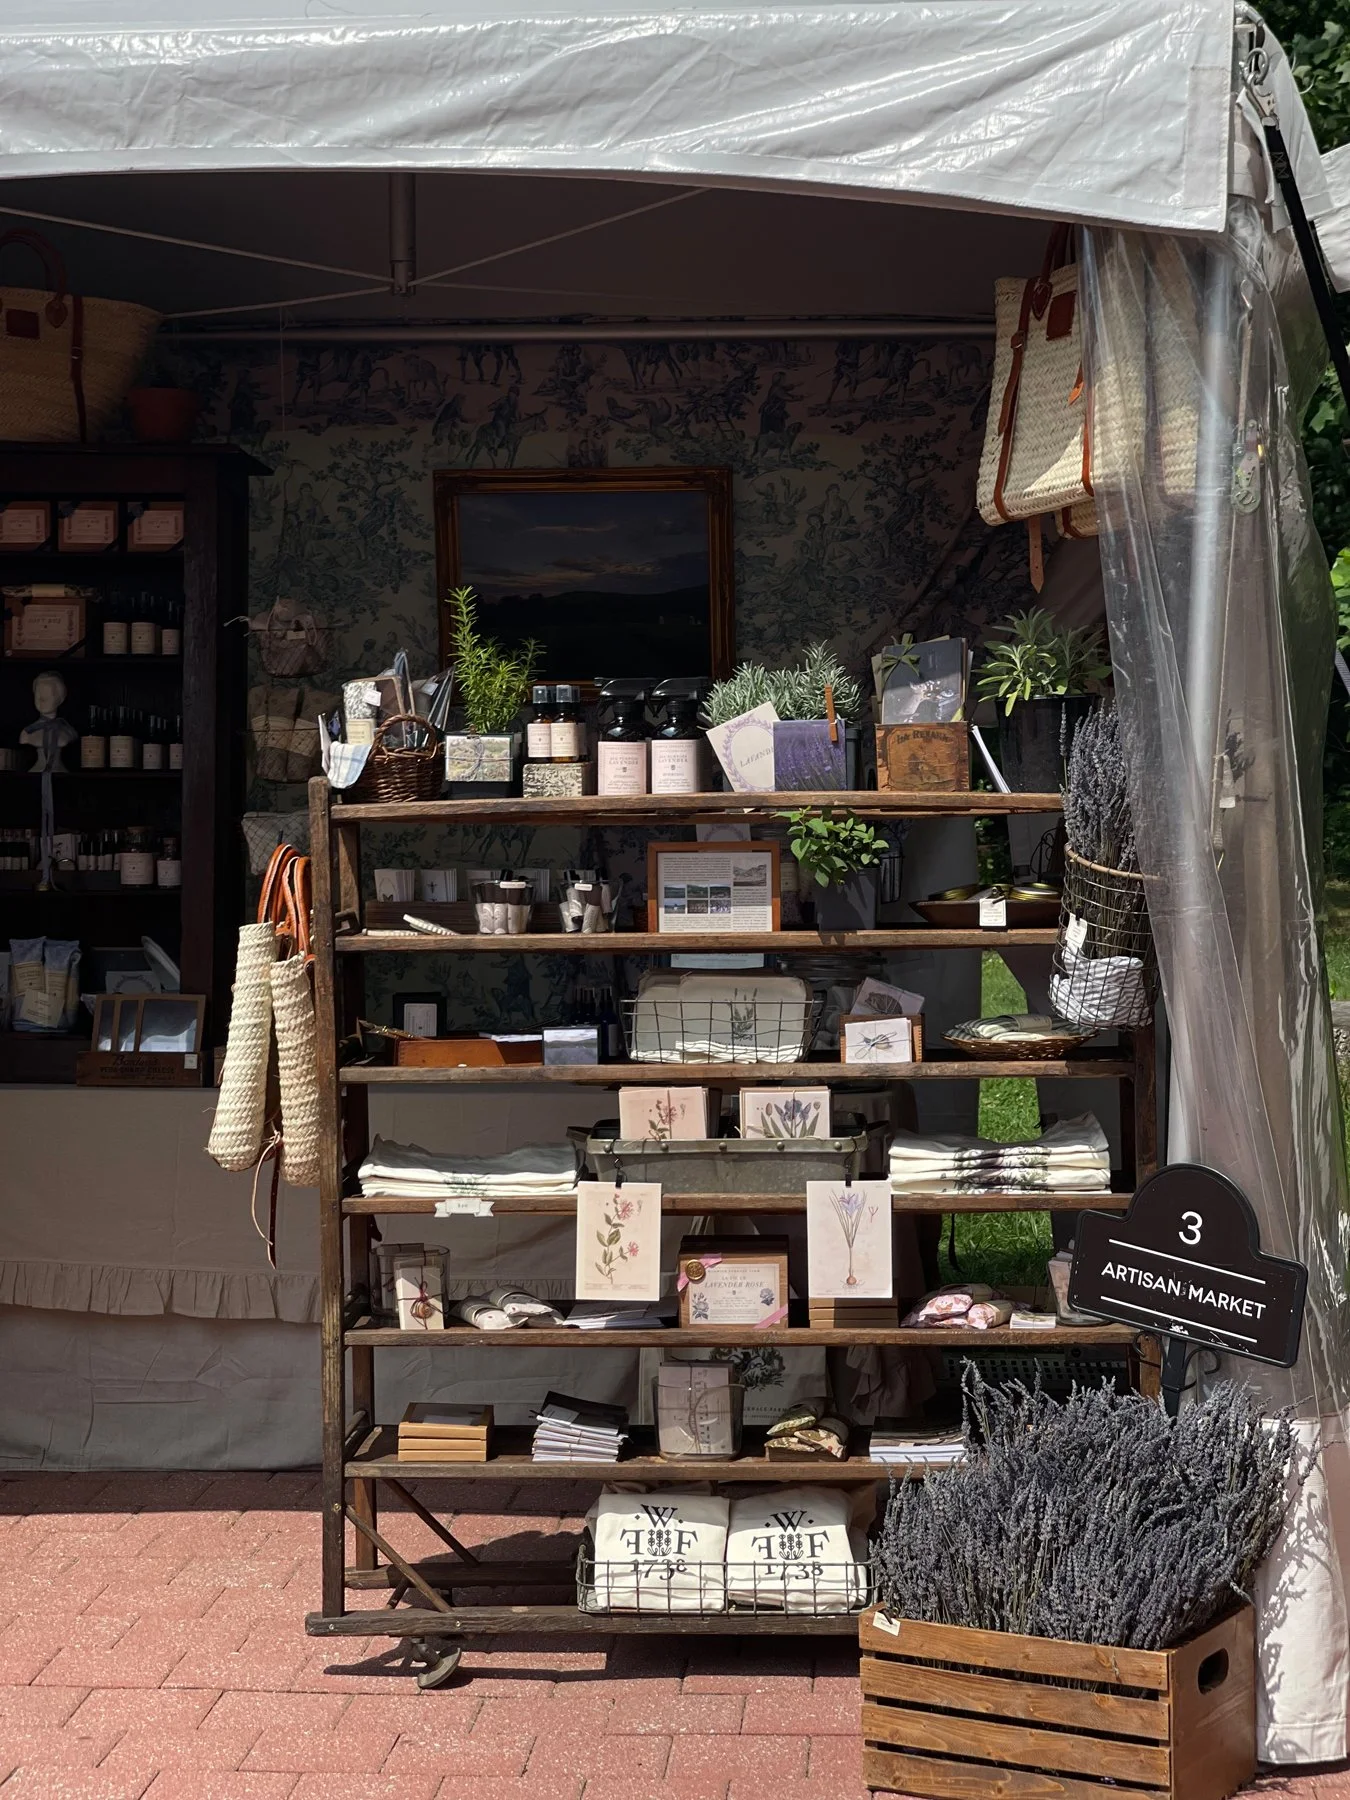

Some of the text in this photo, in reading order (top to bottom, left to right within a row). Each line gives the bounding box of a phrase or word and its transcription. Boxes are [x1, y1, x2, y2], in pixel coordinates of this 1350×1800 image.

[1178, 1210, 1203, 1245] 3
[1101, 1261, 1267, 1319] ARTISAN MARKET
[641, 1504, 678, 1528] W
[770, 1510, 807, 1533] W
[630, 1559, 688, 1581] 1738
[764, 1561, 824, 1581] 1738
